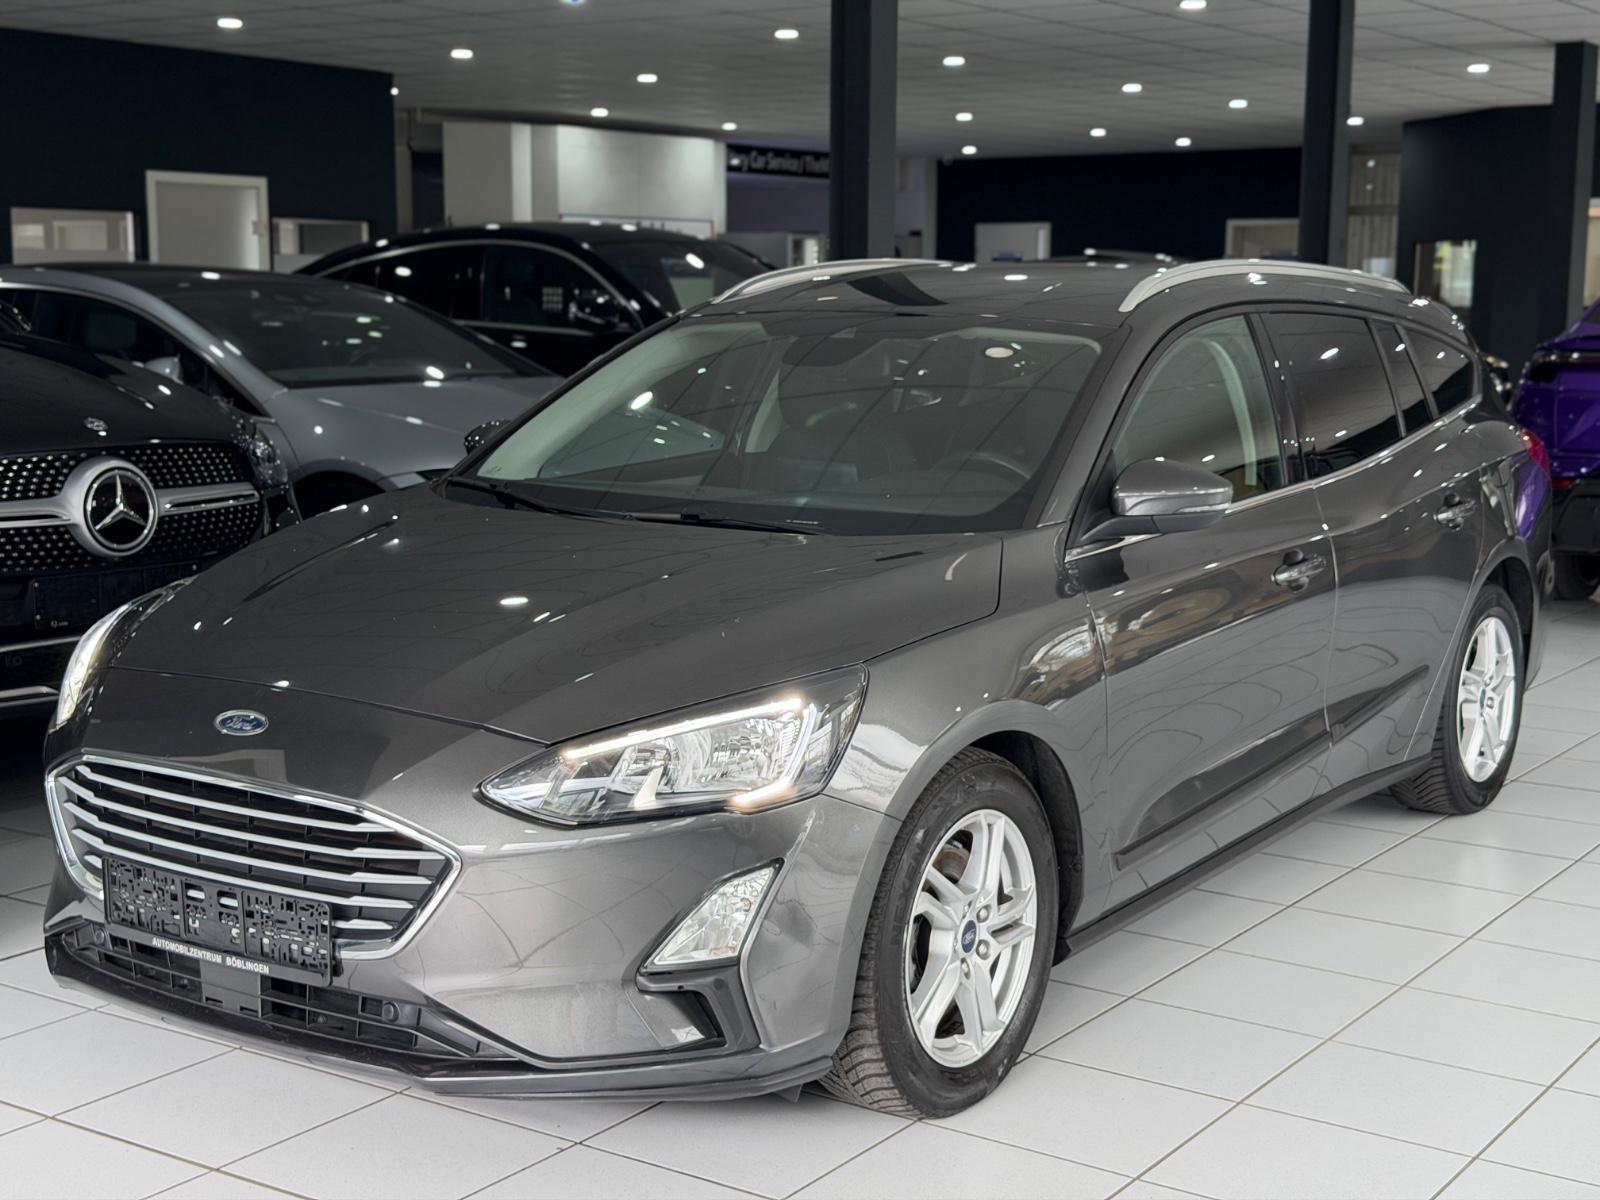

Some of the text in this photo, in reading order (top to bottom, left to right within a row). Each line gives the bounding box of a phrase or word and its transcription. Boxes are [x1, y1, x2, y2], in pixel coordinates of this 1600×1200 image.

[222, 713, 262, 732] Ford
[152, 937, 270, 975] AUTOMOBILZENTRUM BÖBLINGEN
